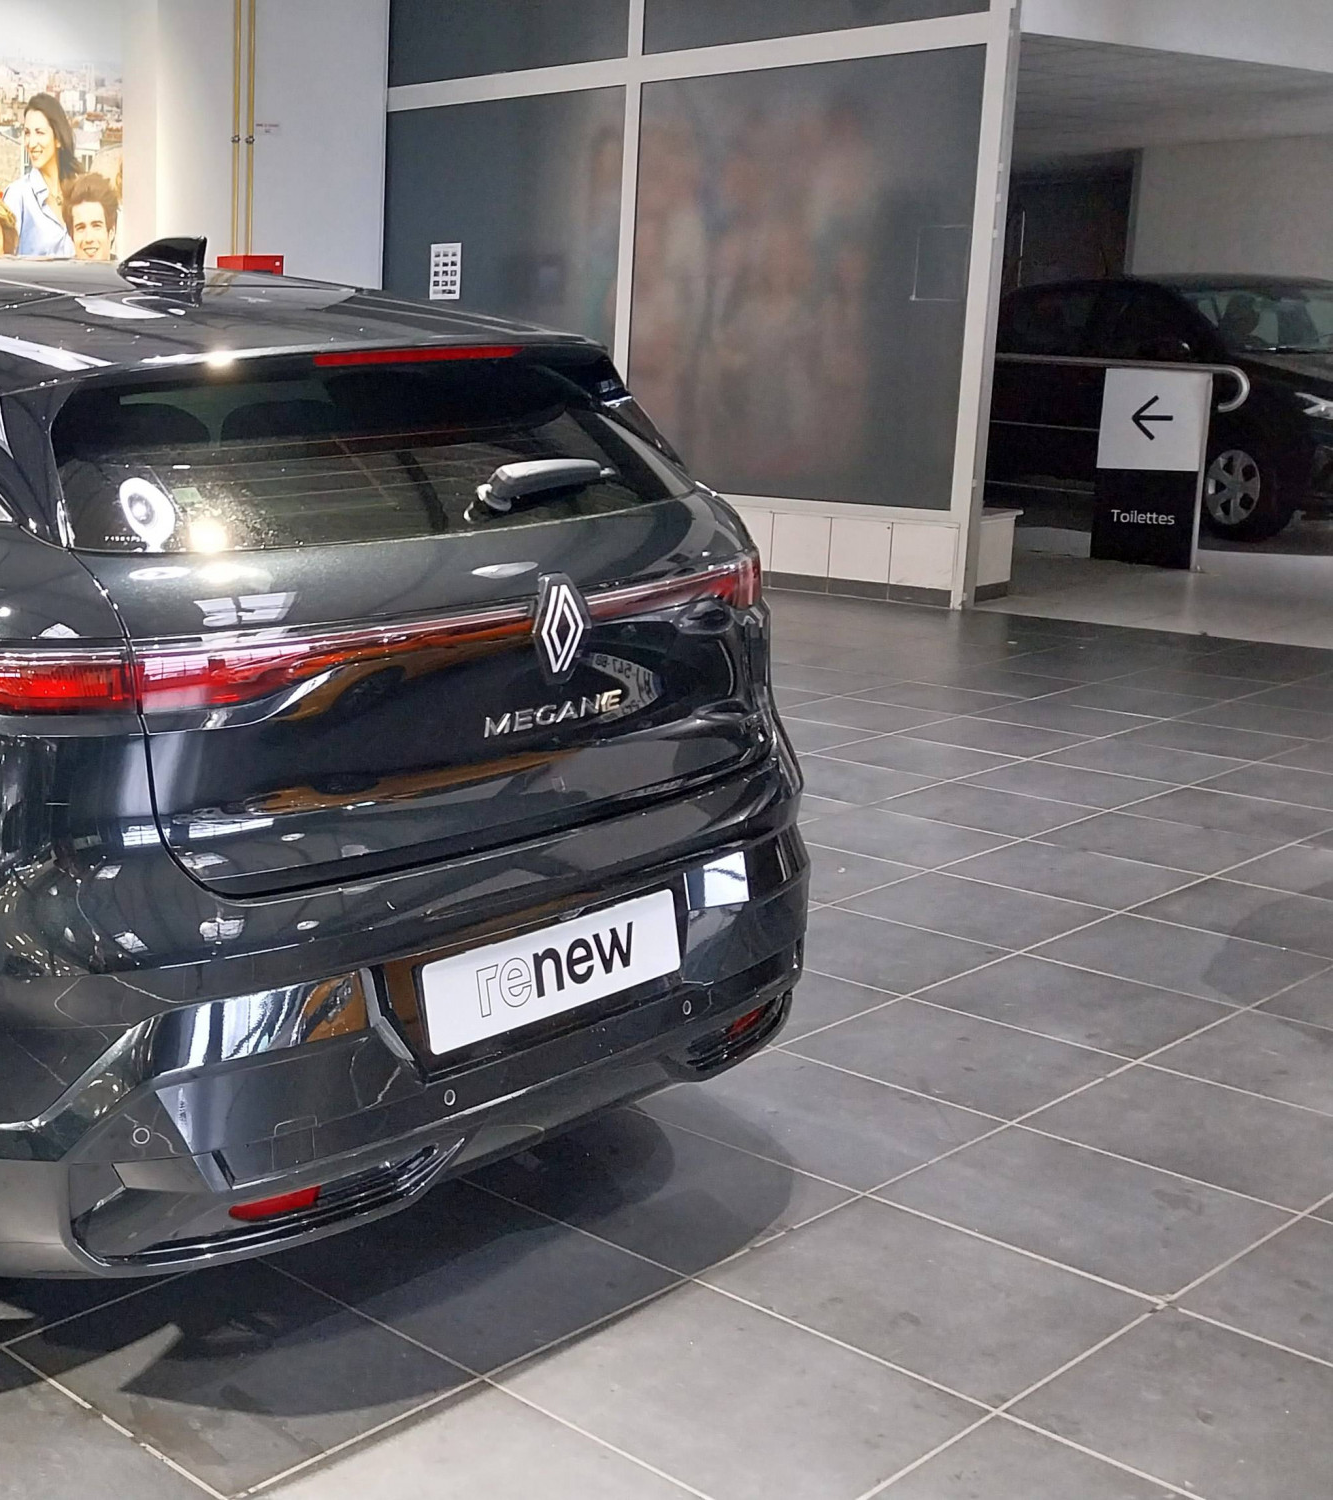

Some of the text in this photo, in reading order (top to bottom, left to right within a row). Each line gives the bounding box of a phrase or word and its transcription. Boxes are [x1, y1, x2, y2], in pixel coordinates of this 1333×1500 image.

[1110, 509, 1175, 525] Toilettes
[483, 689, 622, 738] MEGANE
[476, 921, 633, 1017] renew
